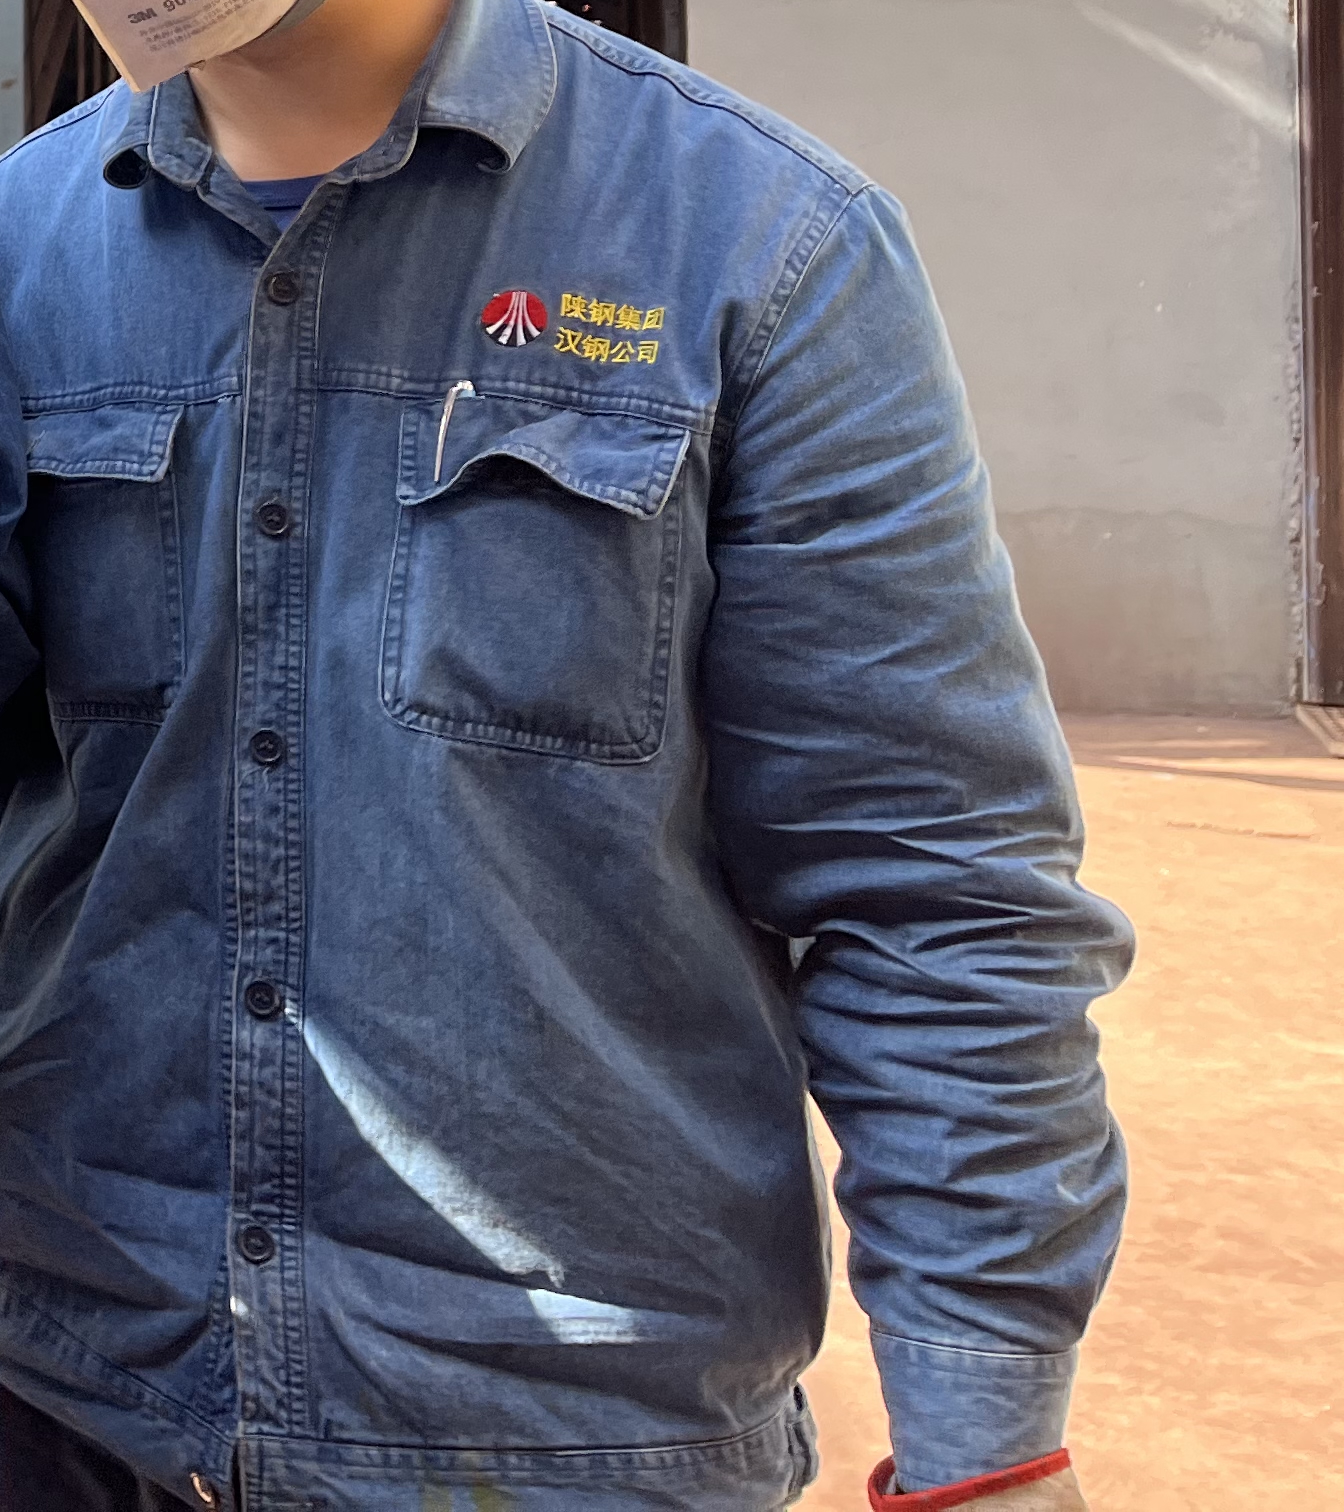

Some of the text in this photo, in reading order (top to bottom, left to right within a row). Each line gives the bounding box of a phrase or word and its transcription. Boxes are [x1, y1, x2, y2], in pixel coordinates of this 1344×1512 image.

[128, 7, 158, 24] 3M
[559, 292, 665, 331] 陕钢集团
[553, 326, 660, 365] 汉钢公司
